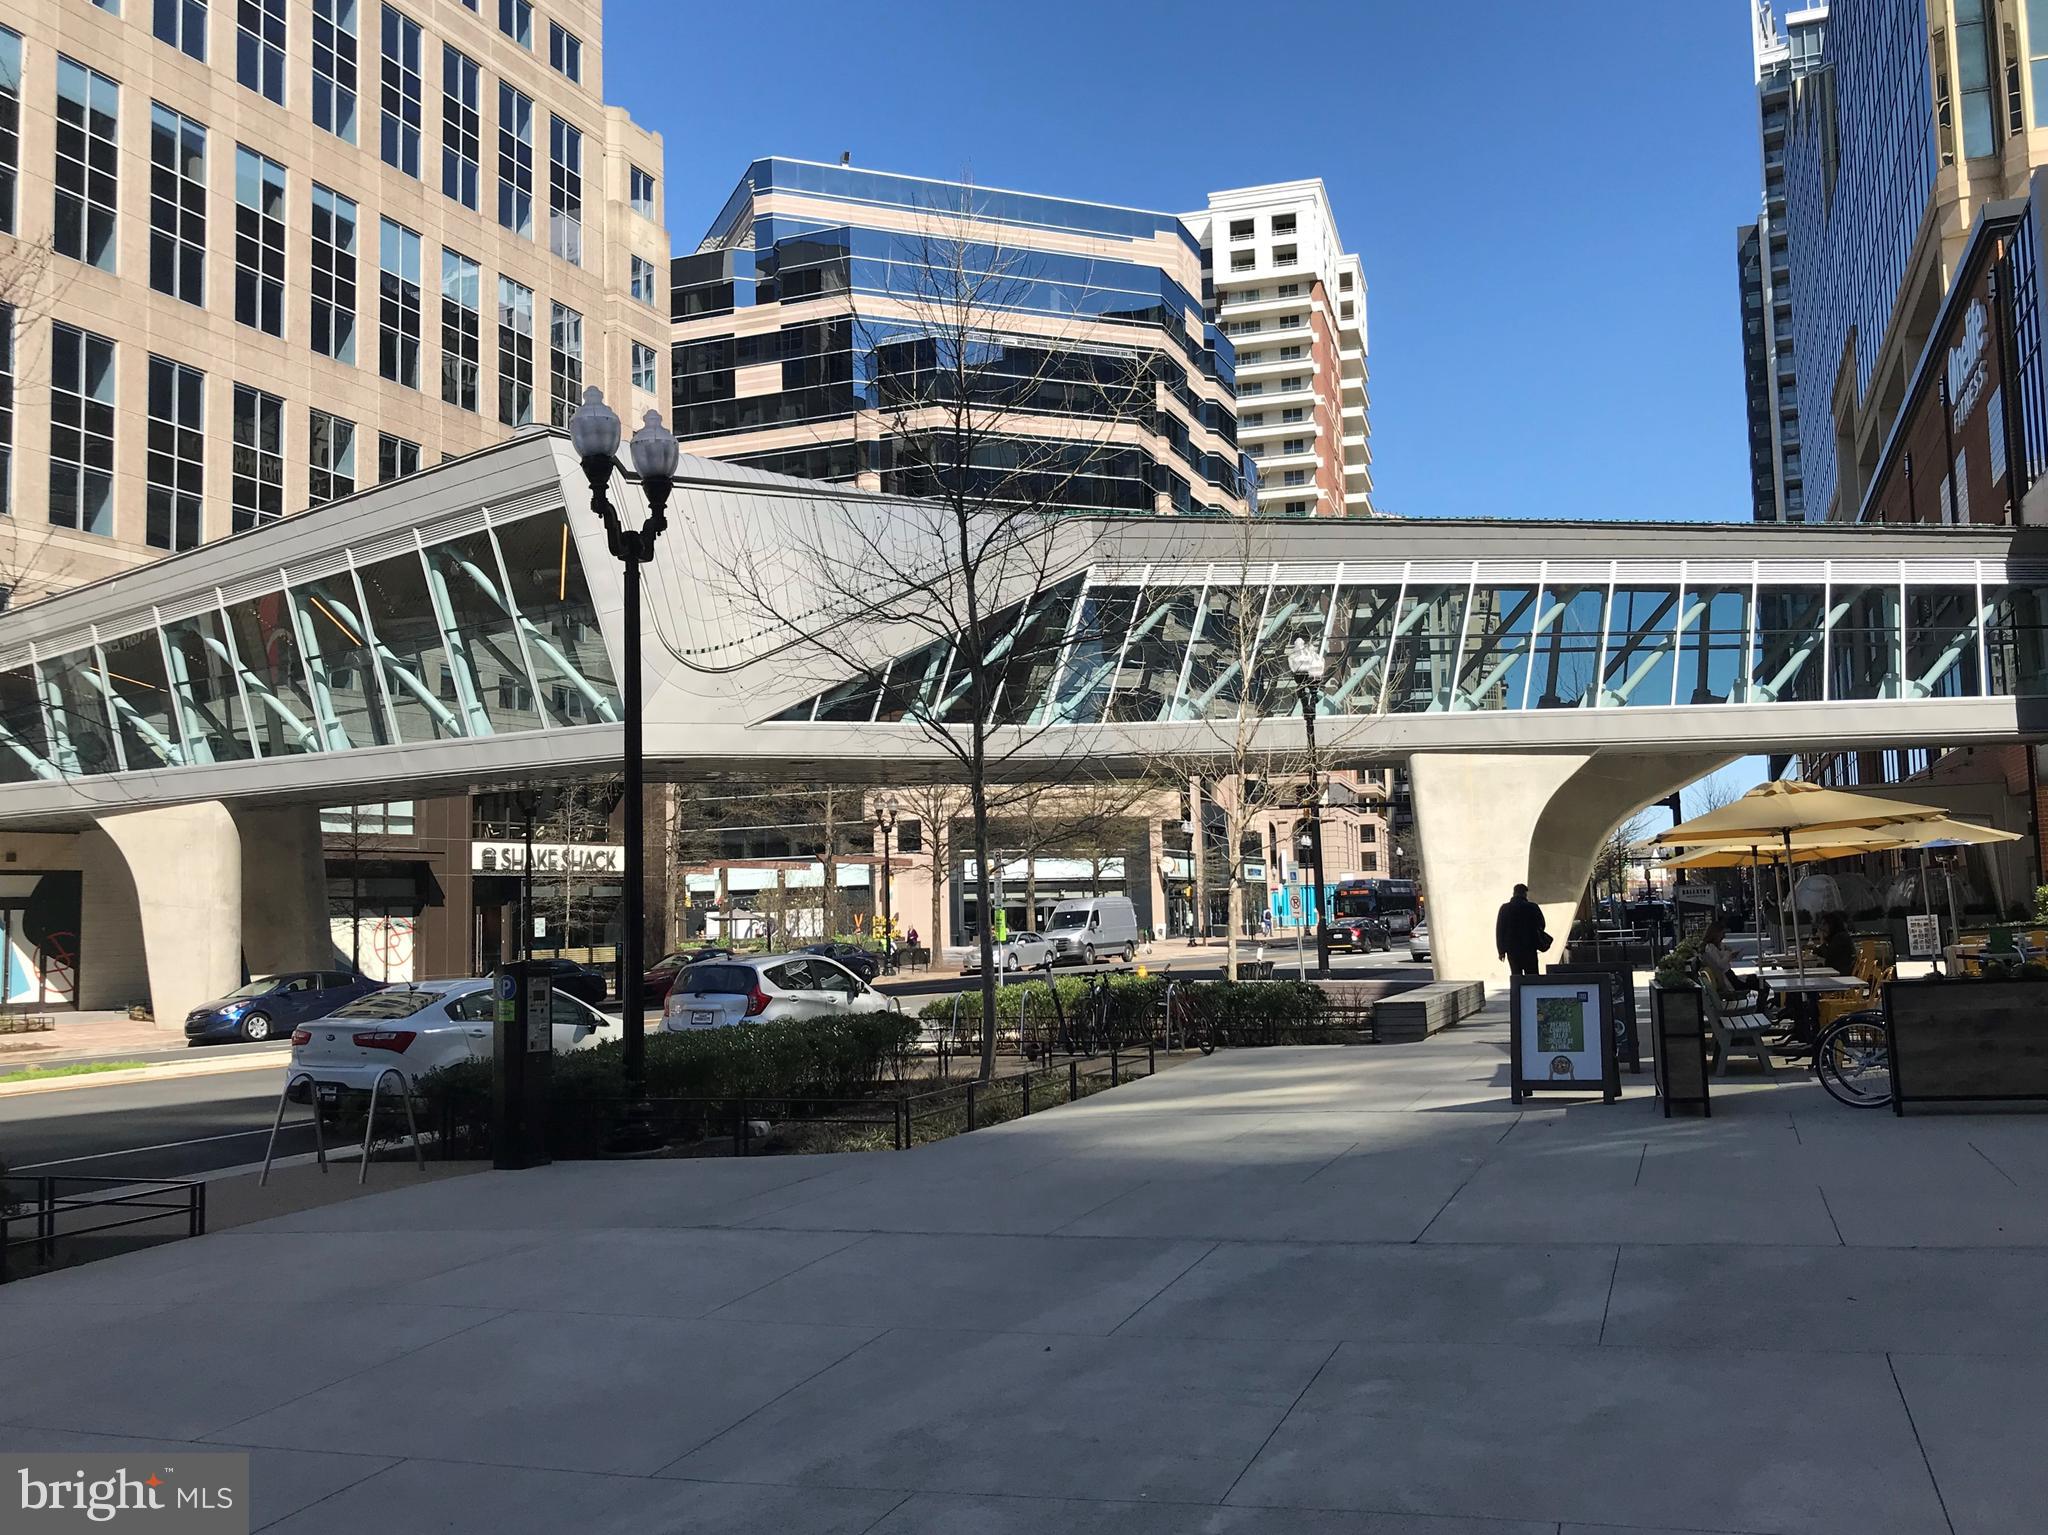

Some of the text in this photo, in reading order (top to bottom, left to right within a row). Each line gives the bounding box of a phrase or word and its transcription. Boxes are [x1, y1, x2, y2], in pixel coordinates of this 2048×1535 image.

[1953, 360, 1988, 434] FITNESS
[501, 848, 617, 872] SHAKE SHACK
